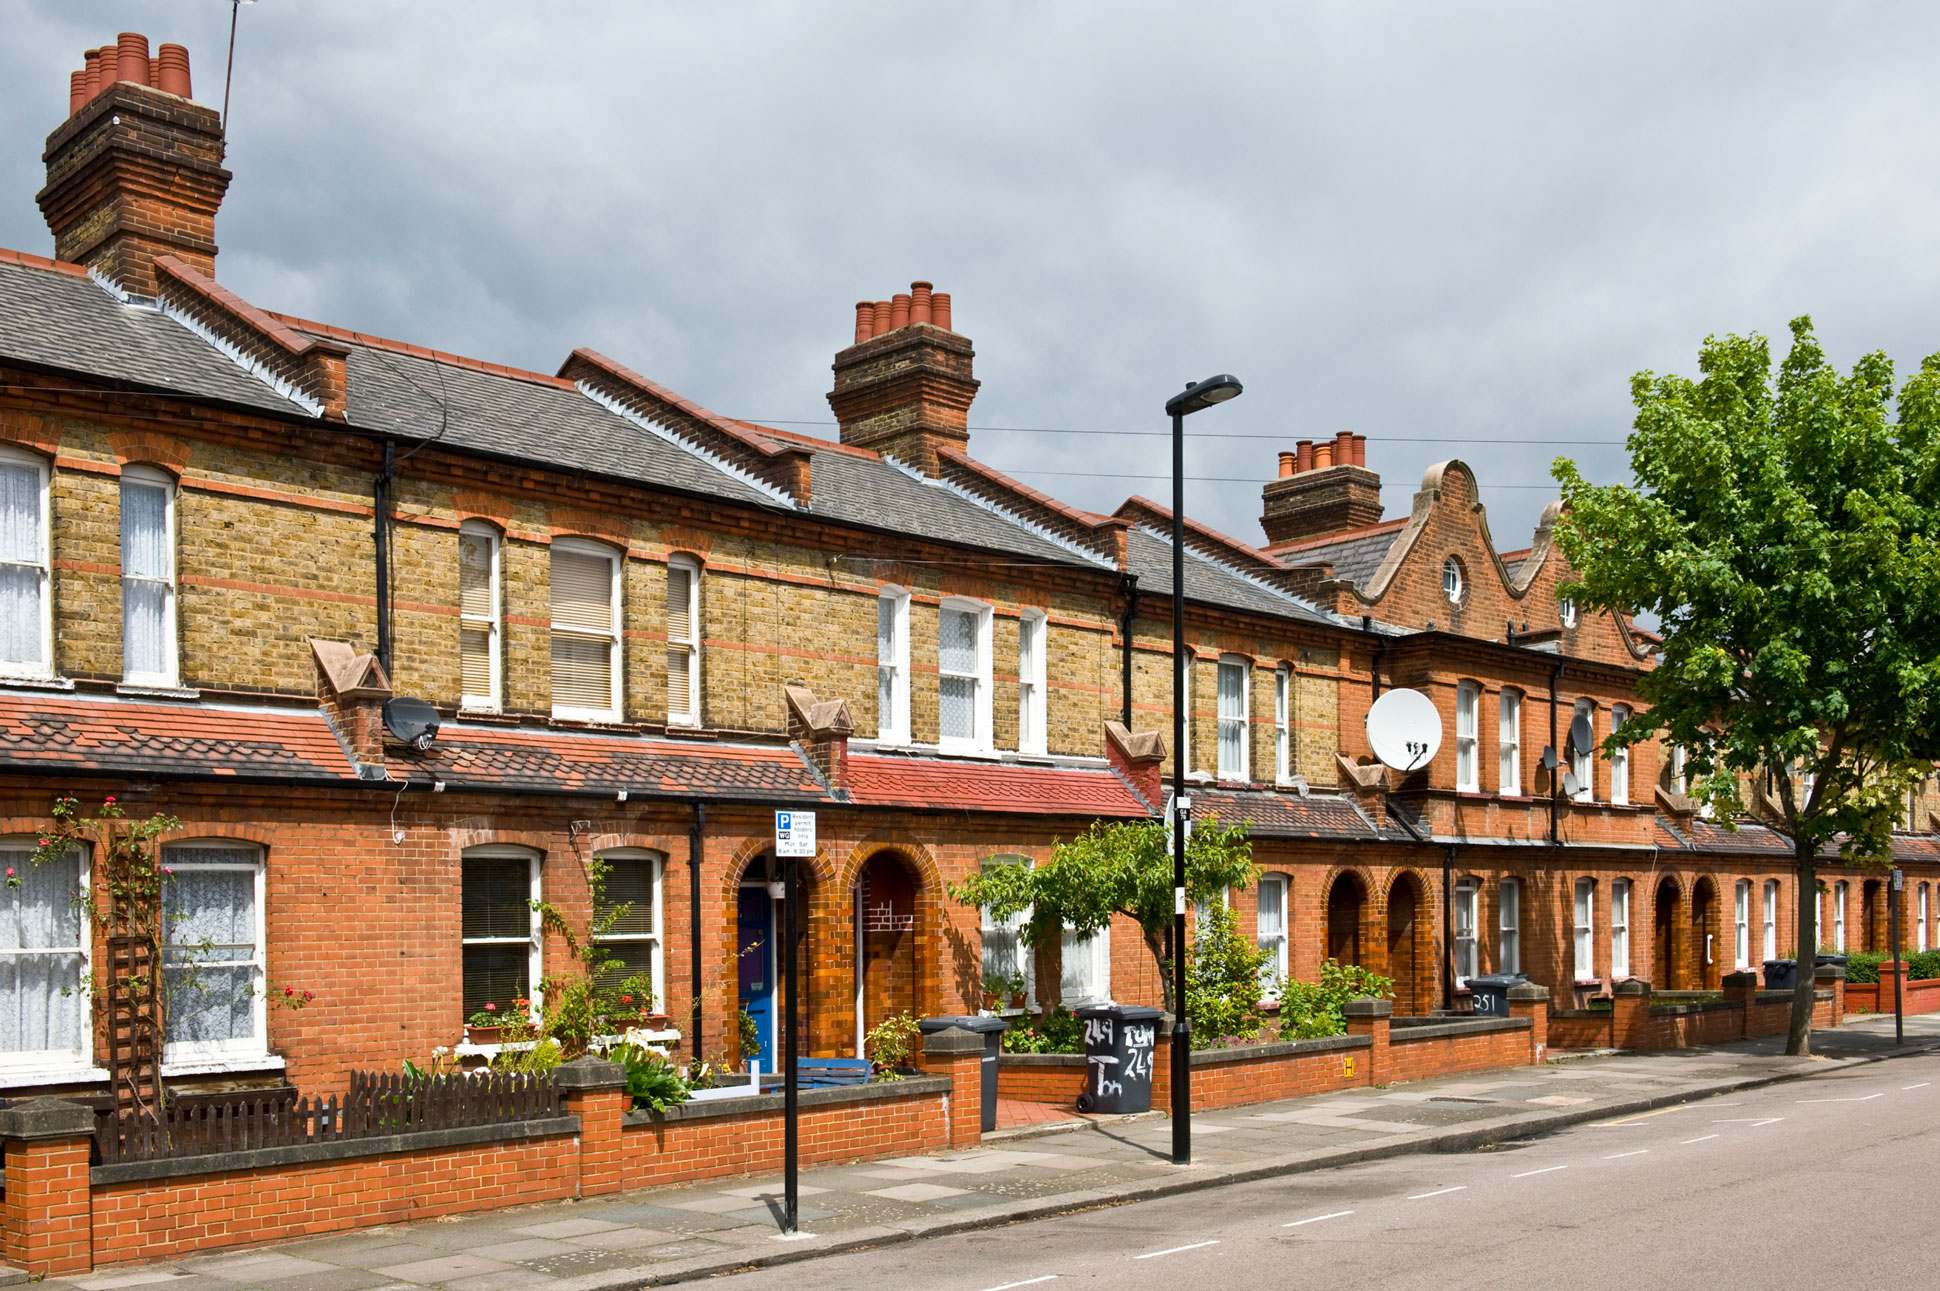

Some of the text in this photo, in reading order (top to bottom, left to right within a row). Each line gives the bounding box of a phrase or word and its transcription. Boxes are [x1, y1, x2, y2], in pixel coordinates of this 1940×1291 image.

[780, 815, 789, 828] P
[1473, 994, 1495, 1012] 251
[1084, 1018, 1113, 1046] 249
[1124, 1048, 1154, 1084] 249
[1345, 1059, 1352, 1075] H
